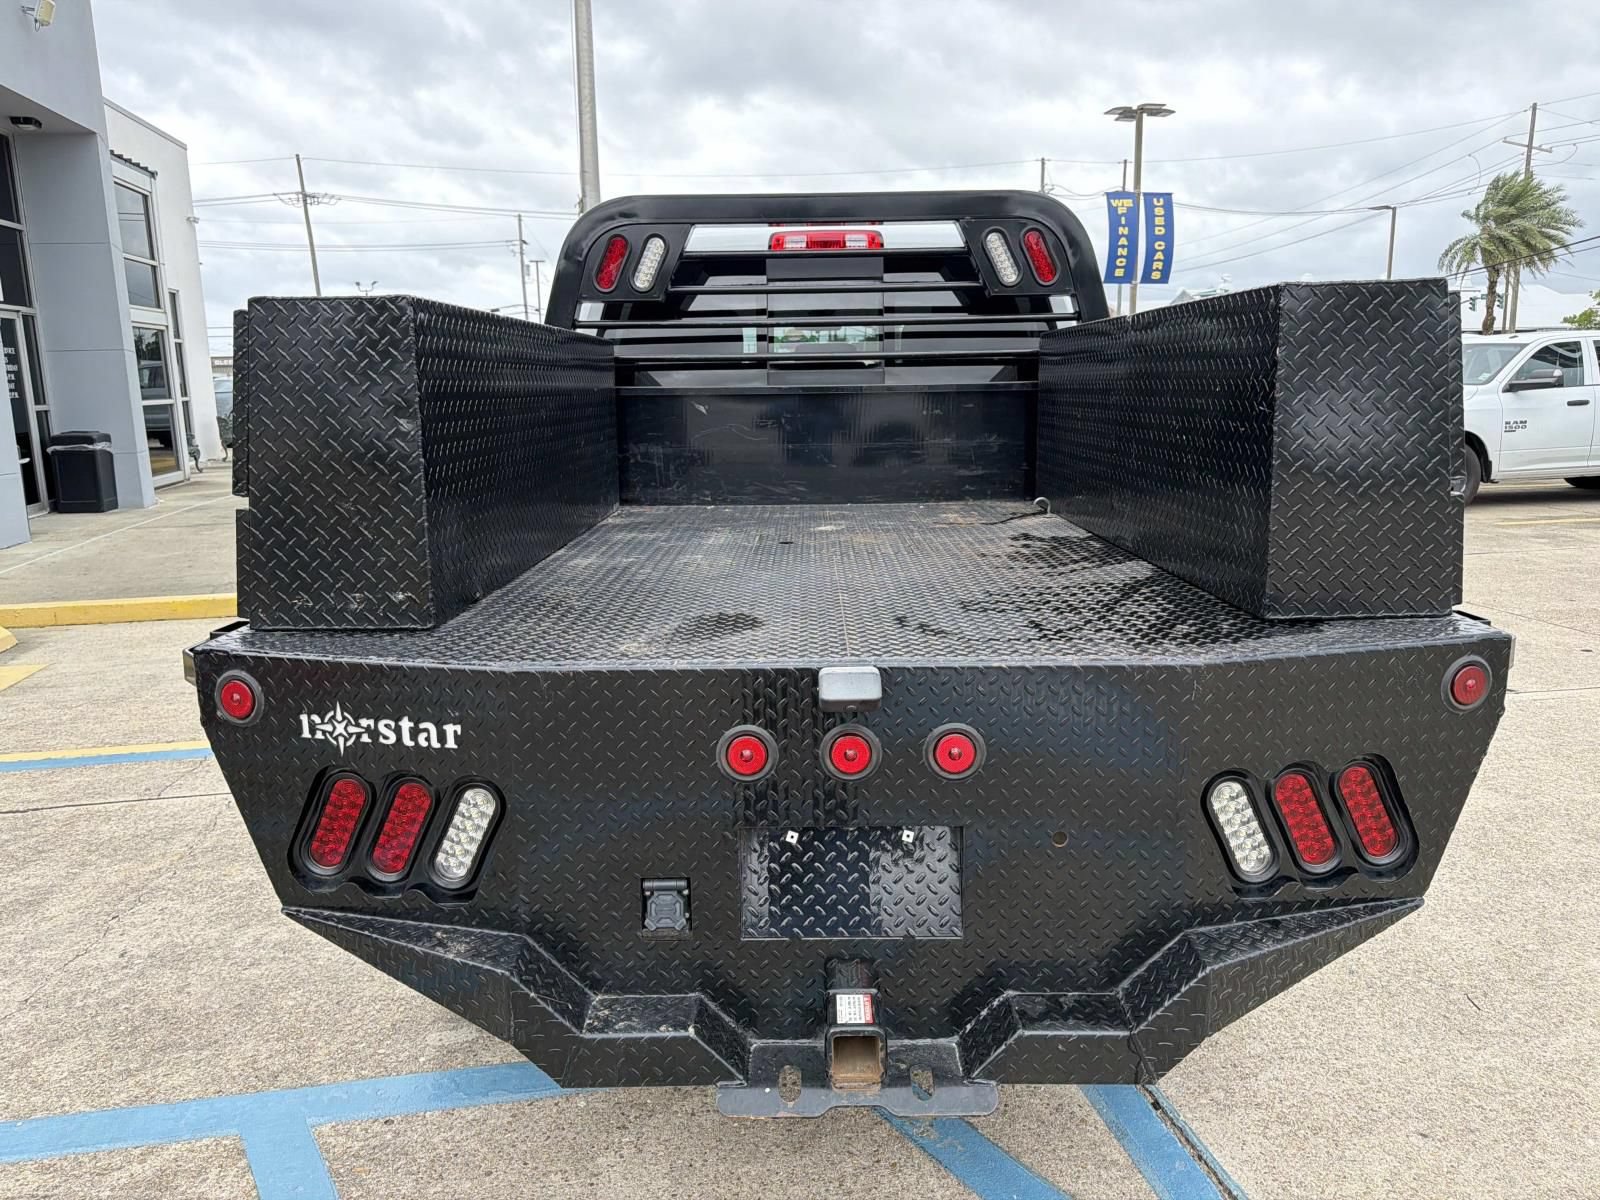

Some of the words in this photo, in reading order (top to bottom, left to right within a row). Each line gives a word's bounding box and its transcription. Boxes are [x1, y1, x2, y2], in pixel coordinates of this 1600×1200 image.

[1110, 199, 1134, 208] WE
[1152, 198, 1166, 236] USED
[1114, 207, 1129, 278] FINANCE
[1151, 241, 1166, 280] CARS
